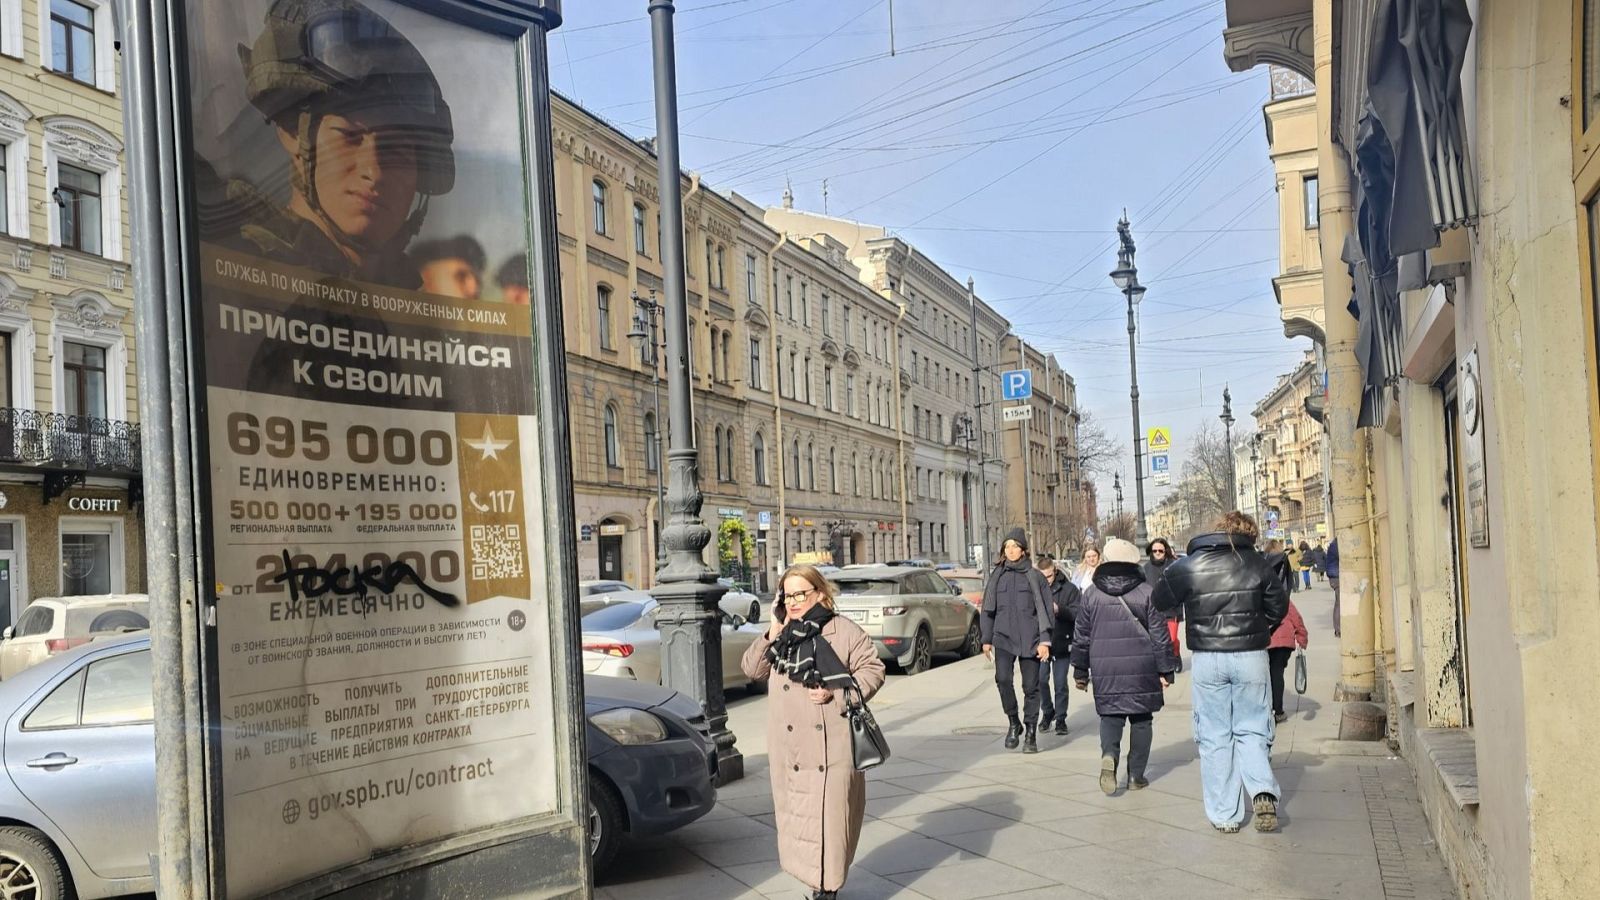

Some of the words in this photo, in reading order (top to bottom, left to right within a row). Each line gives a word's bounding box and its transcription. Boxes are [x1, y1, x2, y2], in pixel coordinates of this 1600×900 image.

[215, 258, 268, 287] СЛУЖБА
[271, 272, 288, 291] ПО
[291, 278, 357, 305] КОНТРАКТУ
[361, 292, 369, 307] В
[372, 294, 464, 322] ВООРУЖЕННЫХ
[467, 308, 507, 326] СИЛАХ
[219, 303, 512, 369] ПРИСОЕДИНЯЙСЯ
[292, 359, 315, 386] К
[323, 364, 443, 398] СВОИМ
[1009, 373, 1026, 397] P
[226, 411, 331, 462] 695
[346, 424, 453, 467] 000
[239, 466, 446, 493] ЕДИНОВРЕМЕННО:
[68, 497, 121, 512] COFFIT
[230, 499, 279, 520] 500
[409, 503, 457, 520] 000
[489, 489, 516, 513] 117
[230, 524, 295, 534] РЕГИОНАЛЬНАЯ
[297, 524, 333, 533] ВЫПЛАТА
[356, 524, 415, 534] ФЕДЕРАЛЬНАЯ
[417, 523, 456, 533] ВЫПЛАТА
[269, 593, 425, 621] ЕЖЕМЕСЯЧНО
[511, 615, 525, 627] 18+
[243, 640, 267, 652] ЗОНЕ
[269, 632, 333, 649] СПЕЦИАЛЬНОЙ
[335, 627, 378, 642] ВОЕННОЙ
[380, 624, 428, 637] ОПЕРАЦИИ
[430, 623, 436, 632] В
[438, 618, 501, 632] ЗАВИСИМОСТИ
[248, 655, 259, 665] ОТ
[262, 649, 313, 663] ВОИНСКОГО
[356, 638, 412, 653] ДОЛЖНОСТИ
[414, 637, 421, 646] И
[424, 632, 465, 646] ВЫСЛУГИ
[467, 630, 487, 641] ЛЕТ)
[234, 693, 320, 719] ВОЗМОЖНОСТЬ
[344, 681, 402, 701] ПОЛУЧИТЬ
[426, 664, 529, 691] ДОПОЛНИТЕЛЬНЫЕ
[234, 714, 310, 740] СОЦИАЛЬНЫЕ
[325, 703, 380, 723] ВЫПЛАТЫ
[395, 697, 417, 712] ПРИ
[432, 681, 529, 706] ТРУДОУСТРОЙСТВЕ
[235, 746, 251, 762] НА
[264, 732, 318, 756] ВЕДУЩИЕ
[331, 716, 414, 742] ПРЕДПРИЯТИЯ
[425, 698, 530, 726] САНКТ-ПЕТЕРБУРГА
[289, 756, 297, 770] В
[299, 746, 350, 768] ТЕЧЕНИЕ
[352, 734, 409, 759] ДЕЙСТВИЯ
[413, 724, 472, 745] КОНТРАКТА
[308, 757, 495, 821] gov.spb.ru/contract
